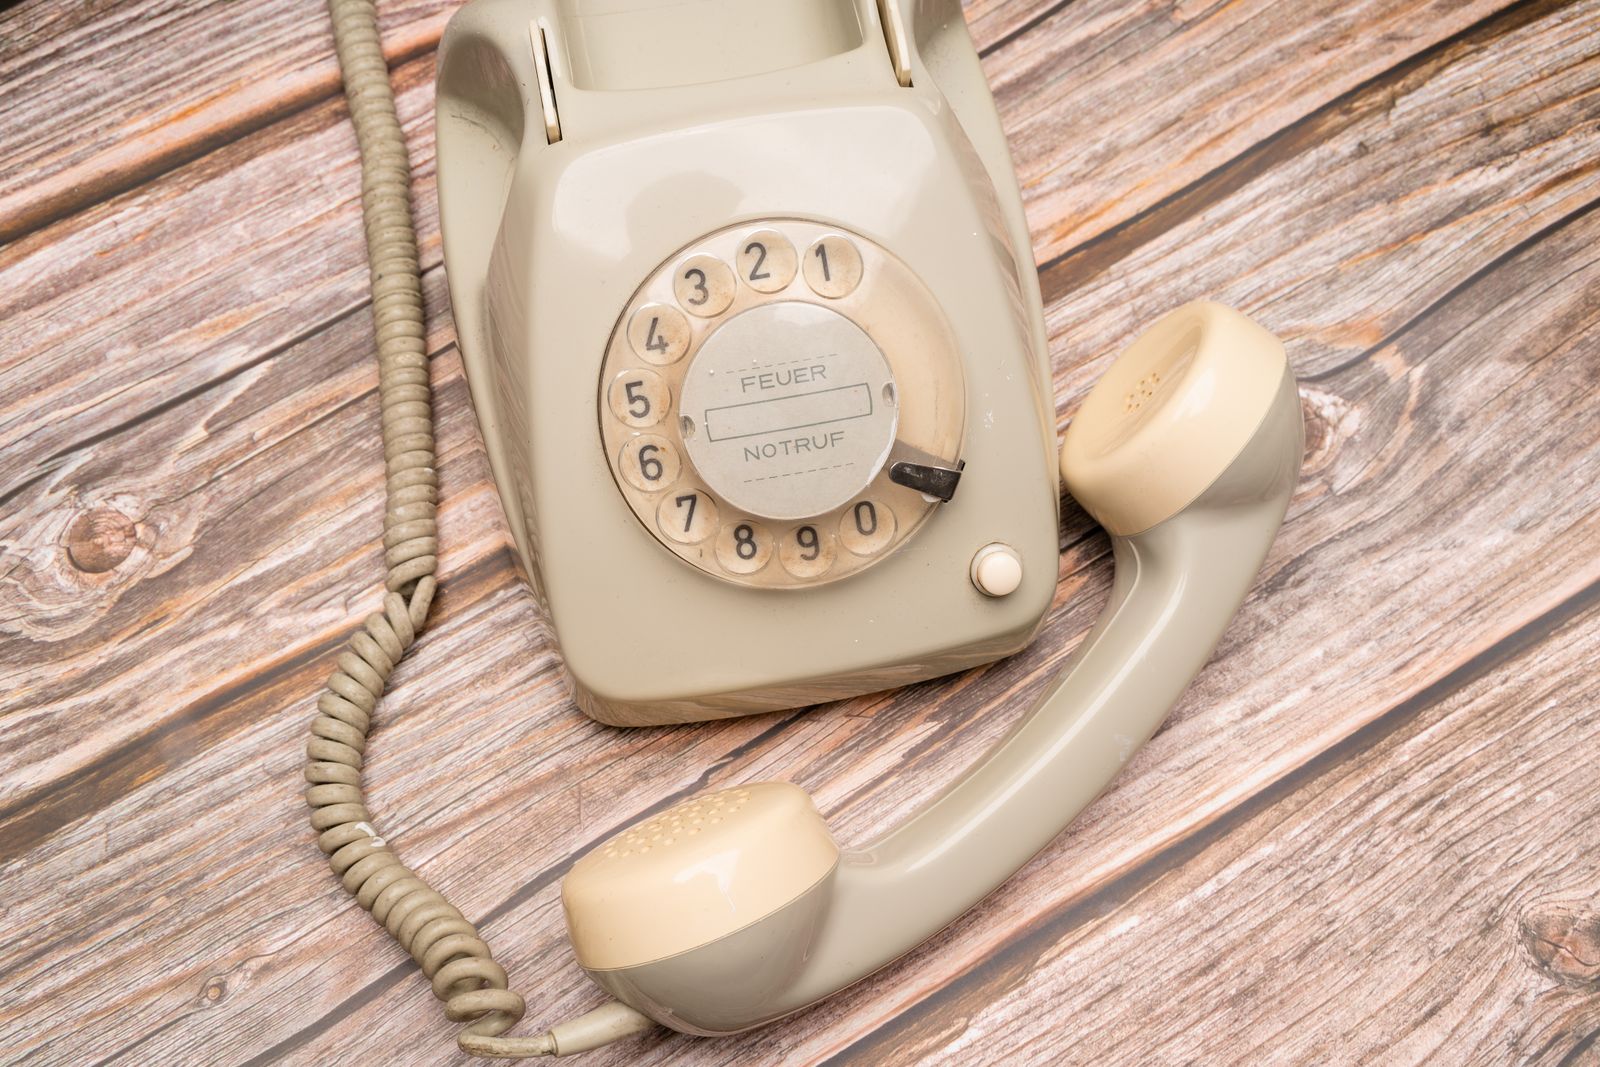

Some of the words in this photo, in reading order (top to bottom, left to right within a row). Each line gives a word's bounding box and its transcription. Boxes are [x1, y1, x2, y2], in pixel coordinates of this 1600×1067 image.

[744, 241, 771, 281] 2
[814, 243, 831, 282] 1
[684, 268, 709, 305] 3
[645, 316, 669, 354] 4
[740, 364, 827, 393] FEUER
[624, 380, 650, 418] 5
[638, 444, 663, 481] 6
[744, 431, 846, 462] NOTRUF
[675, 494, 698, 532] 7
[854, 500, 877, 536] 0
[733, 524, 757, 560] 8
[796, 525, 820, 561] 9
